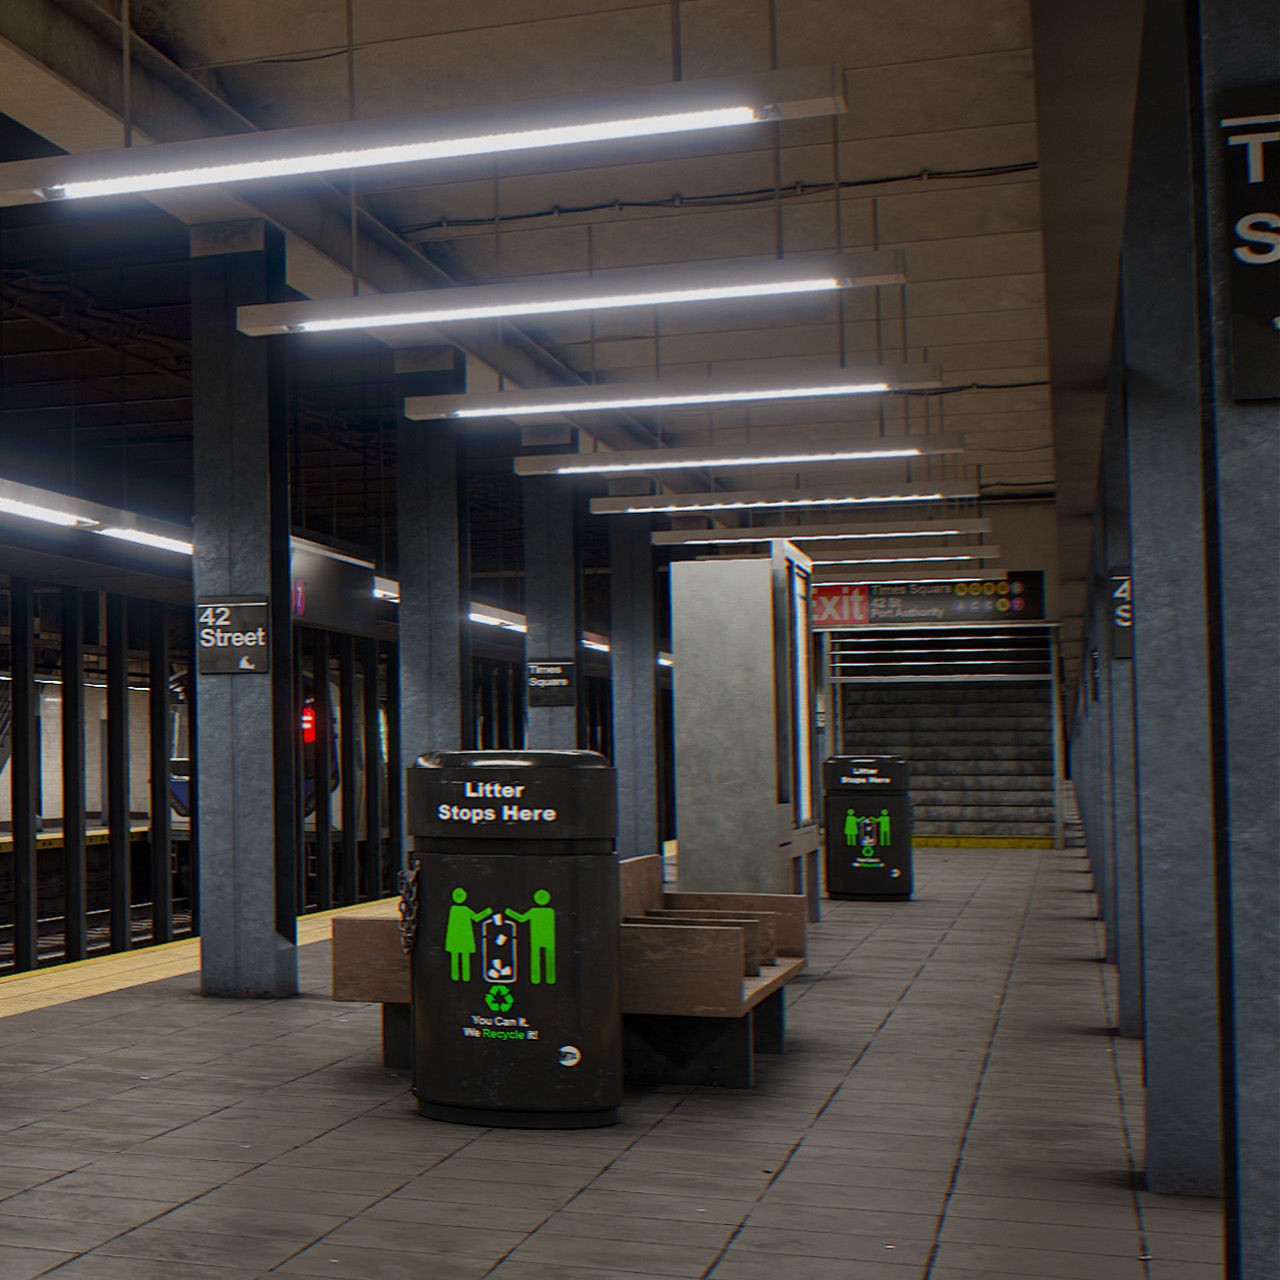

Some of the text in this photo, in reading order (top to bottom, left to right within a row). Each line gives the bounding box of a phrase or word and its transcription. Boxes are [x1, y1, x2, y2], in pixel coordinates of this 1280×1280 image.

[870, 585, 908, 596] Times
[909, 584, 953, 597] Square
[198, 607, 232, 626] 42
[200, 627, 267, 647] Street
[528, 665, 563, 675] Times
[528, 677, 569, 688] Square
[464, 780, 526, 798] Litter
[437, 803, 558, 824] Stops Here
[470, 1014, 493, 1026] You
[493, 1016, 518, 1027] Can
[462, 1027, 482, 1038] We
[482, 1028, 526, 1041] Recycle
